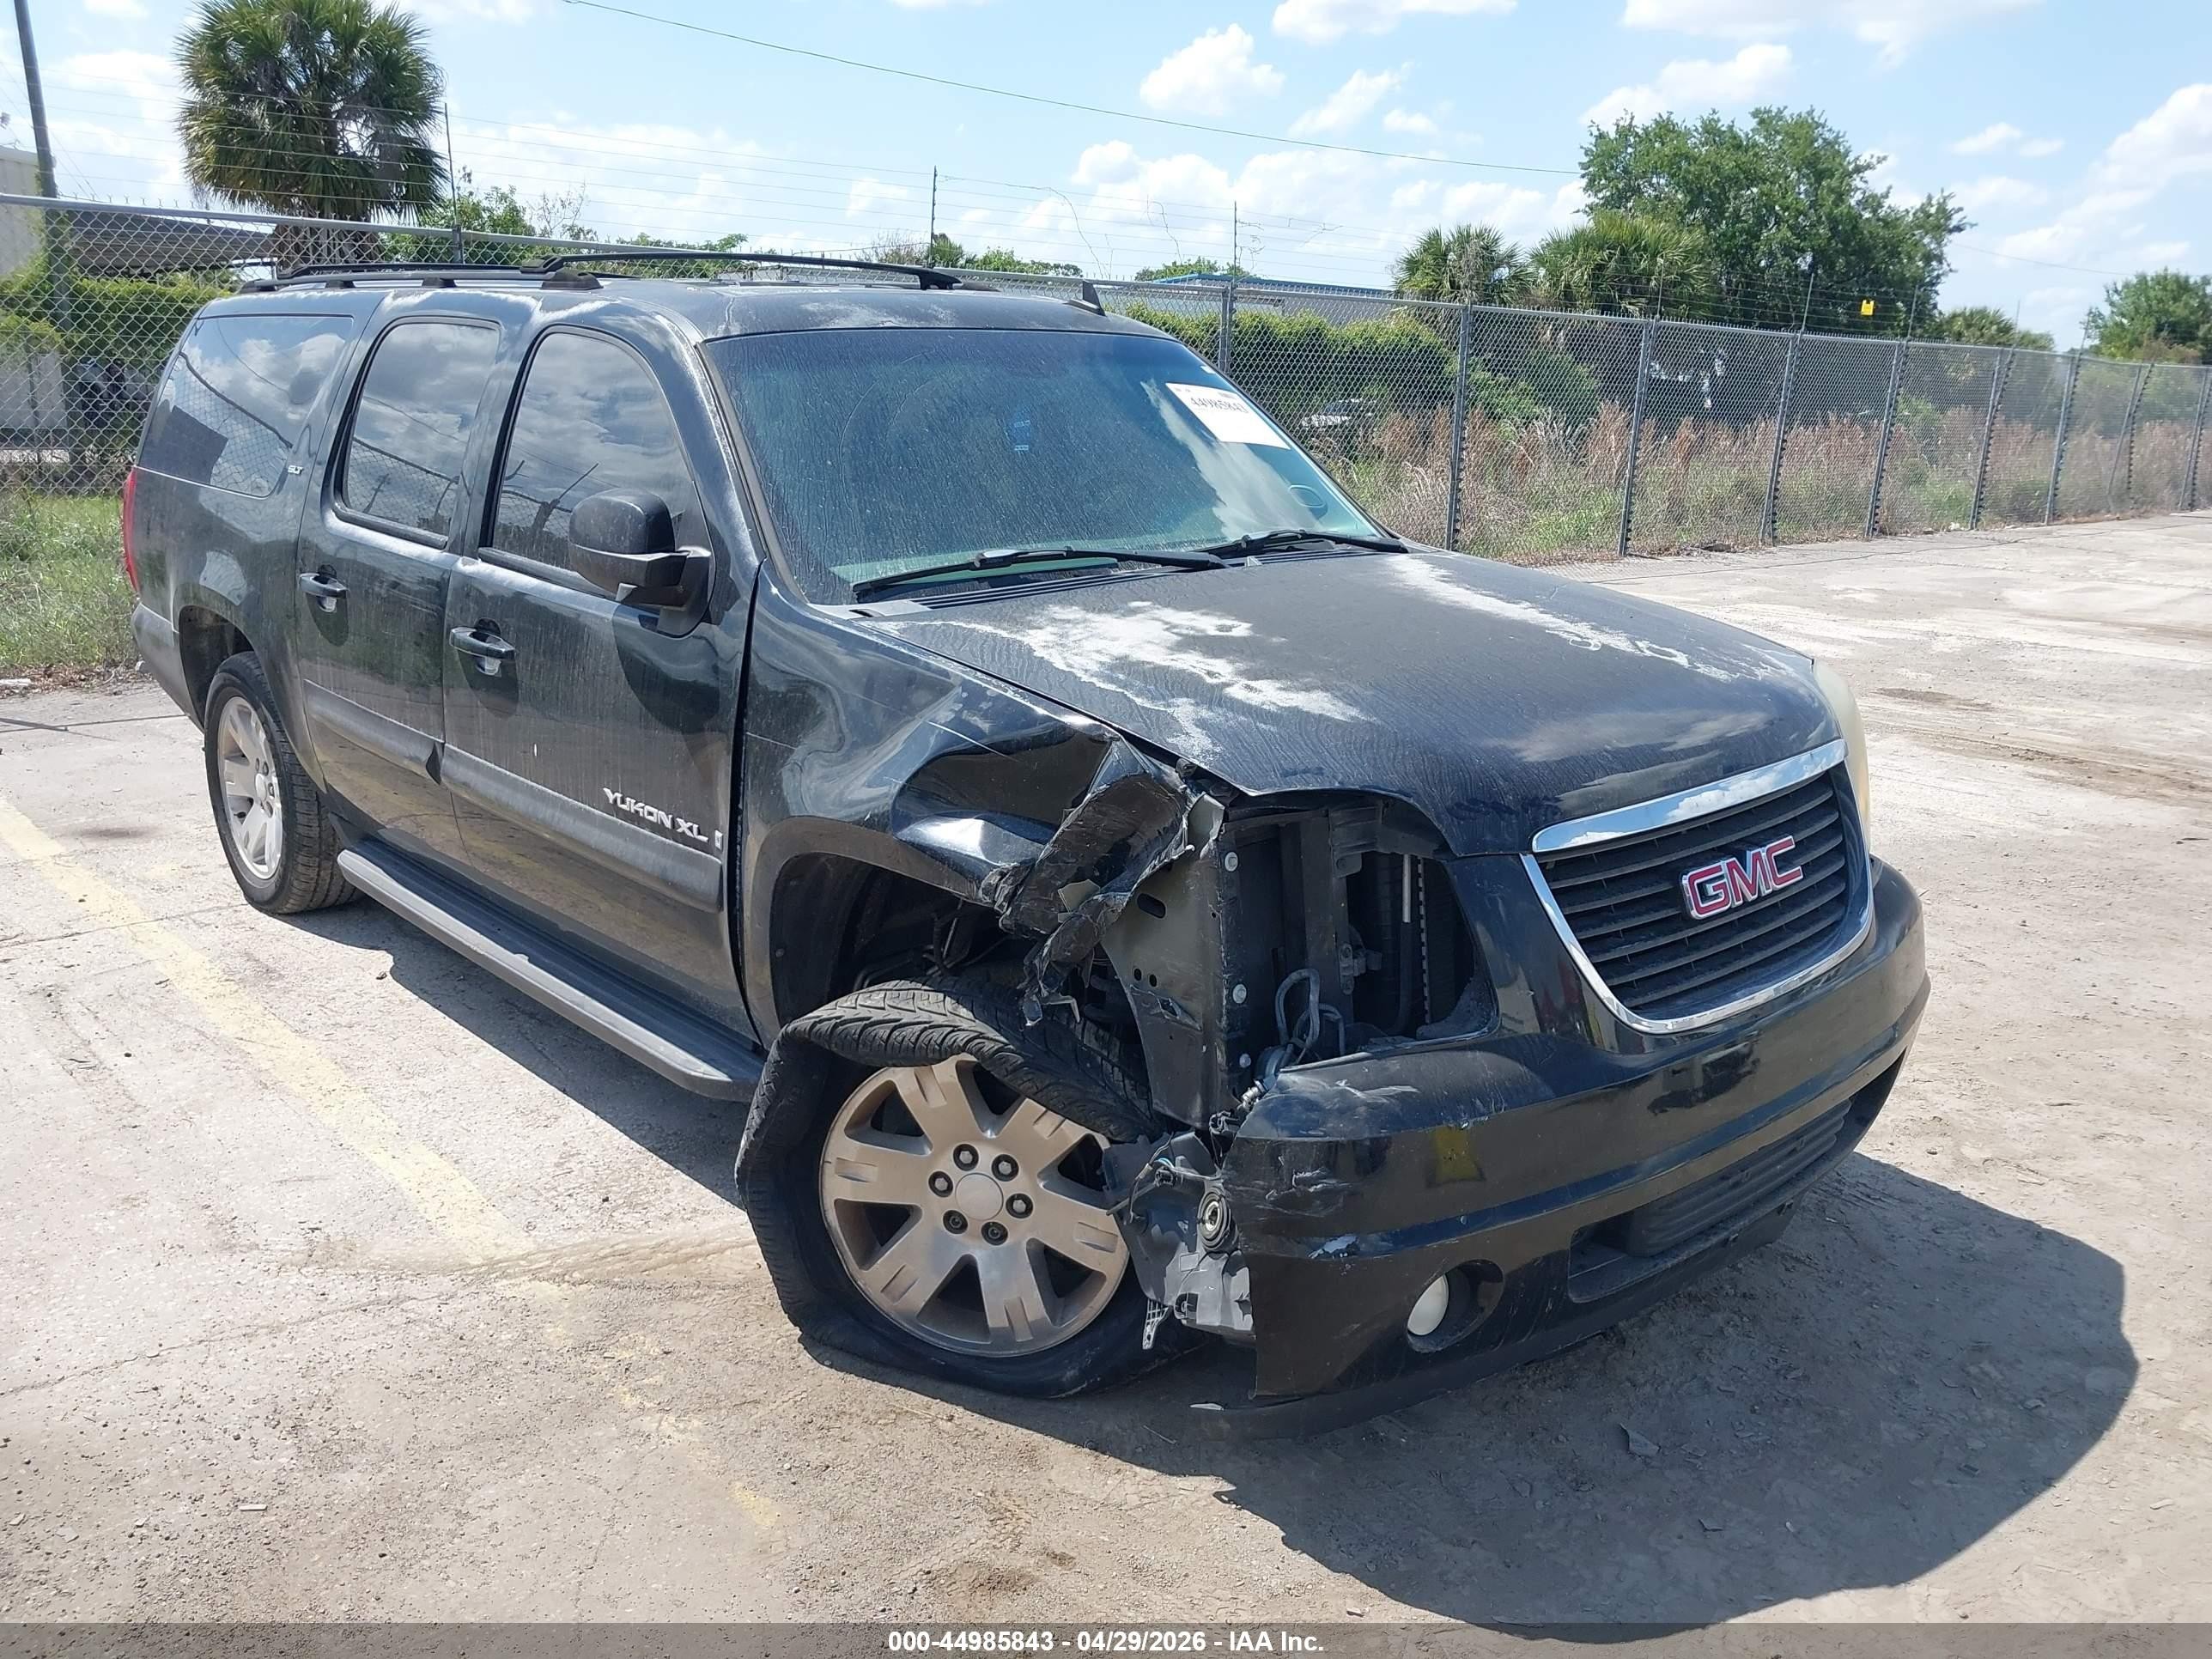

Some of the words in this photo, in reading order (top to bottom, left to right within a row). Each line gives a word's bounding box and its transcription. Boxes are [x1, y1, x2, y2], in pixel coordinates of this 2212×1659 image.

[603, 787, 673, 830] YUKON
[676, 817, 708, 843] XL
[1682, 836, 1804, 921] GMC
